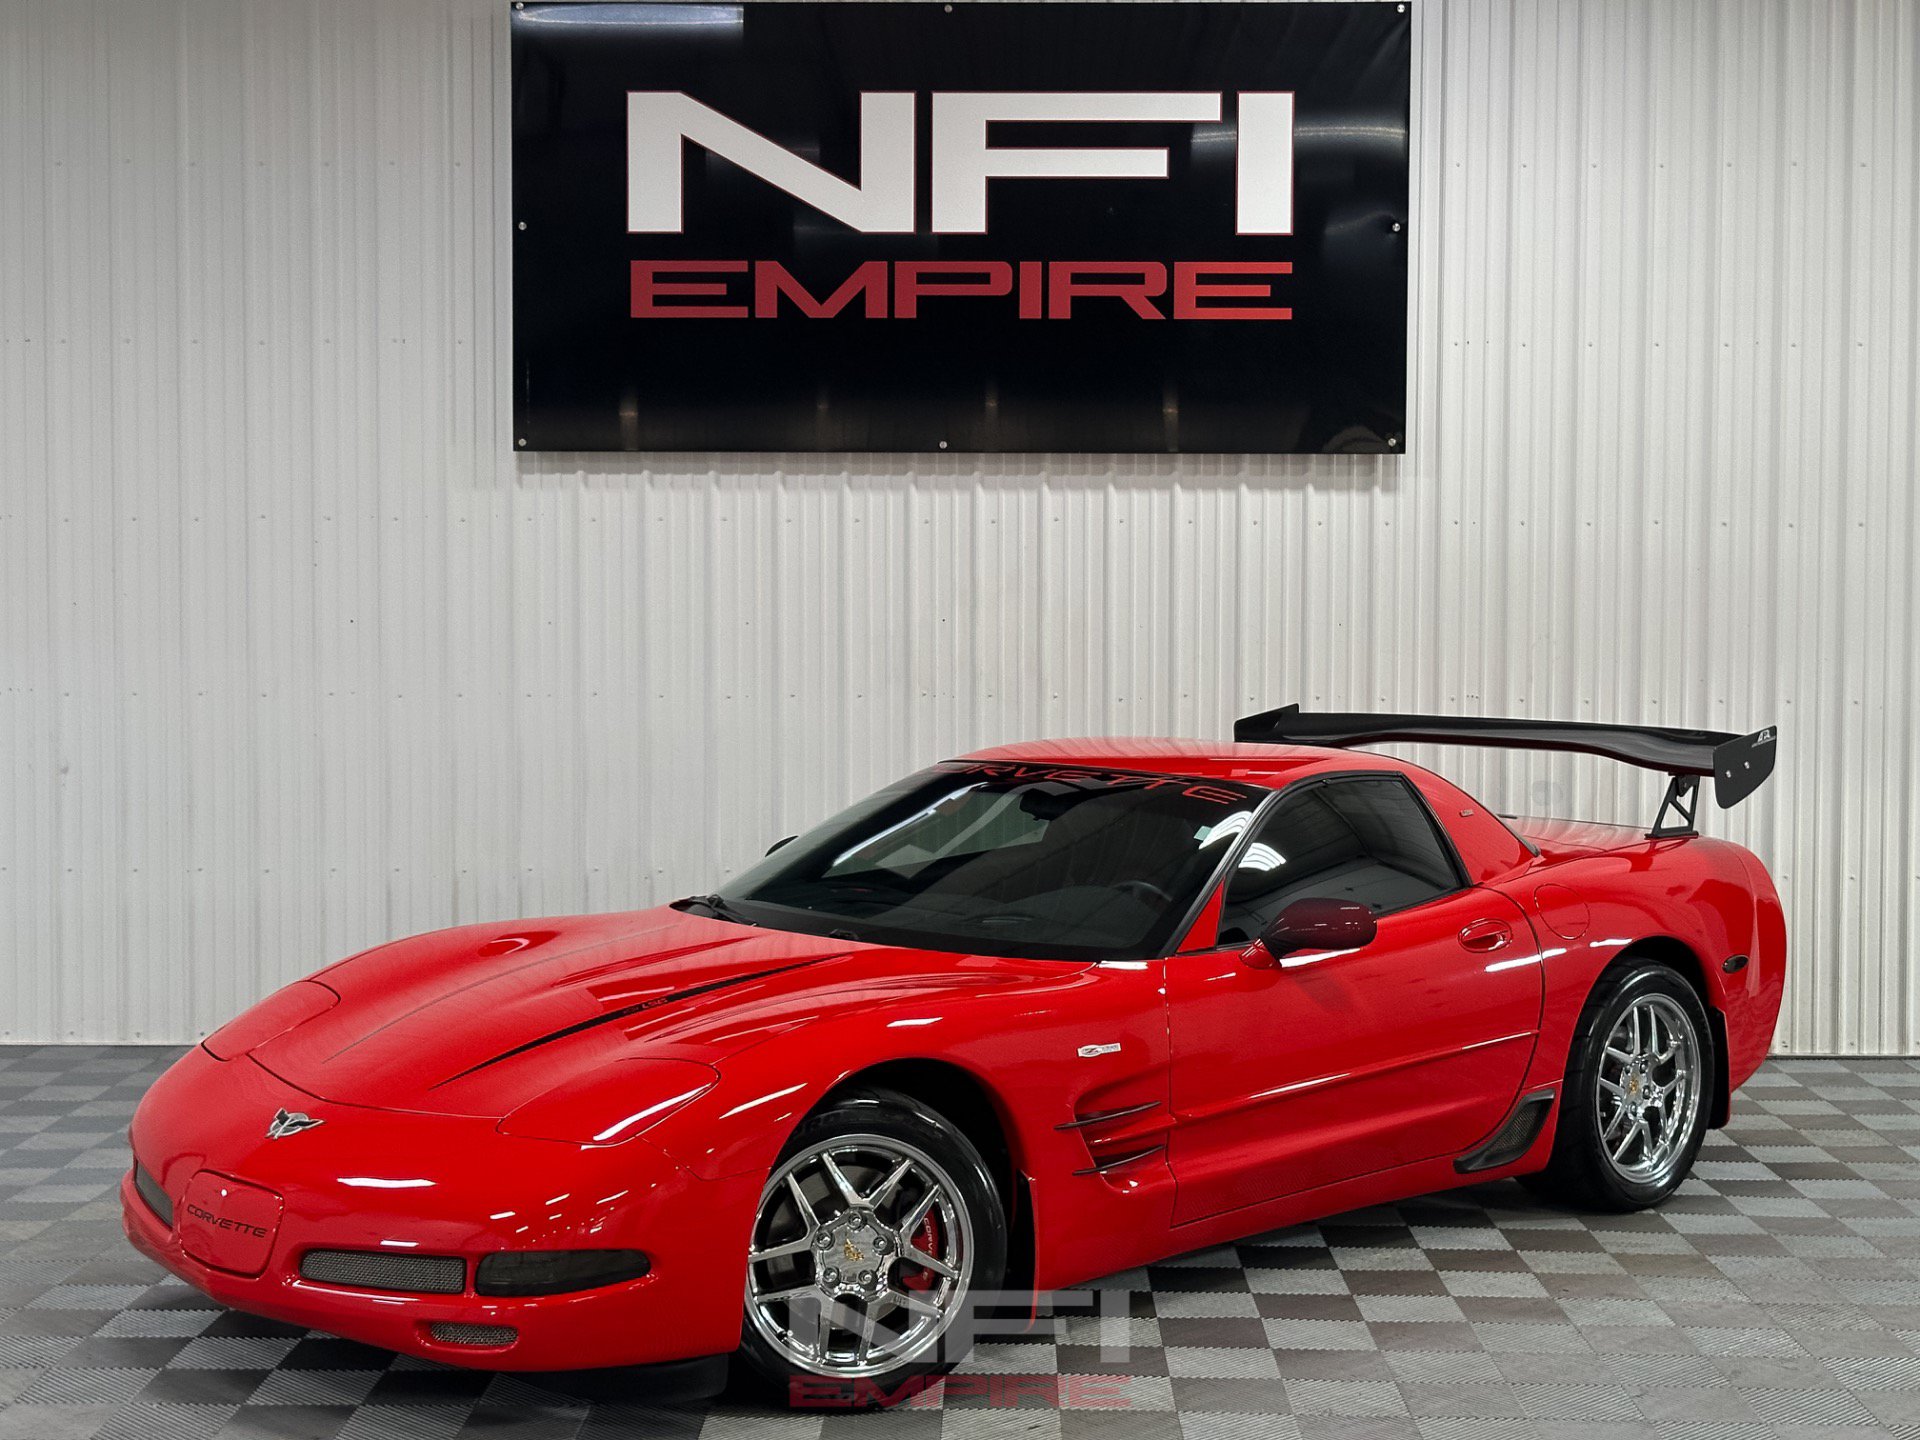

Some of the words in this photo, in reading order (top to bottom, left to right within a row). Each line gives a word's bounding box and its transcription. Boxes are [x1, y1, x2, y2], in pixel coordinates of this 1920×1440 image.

[627, 90, 1294, 235] NFI
[630, 260, 1293, 320] EMPIRE
[934, 763, 1248, 804] ORVETTE
[187, 1204, 268, 1238] CORVETTE
